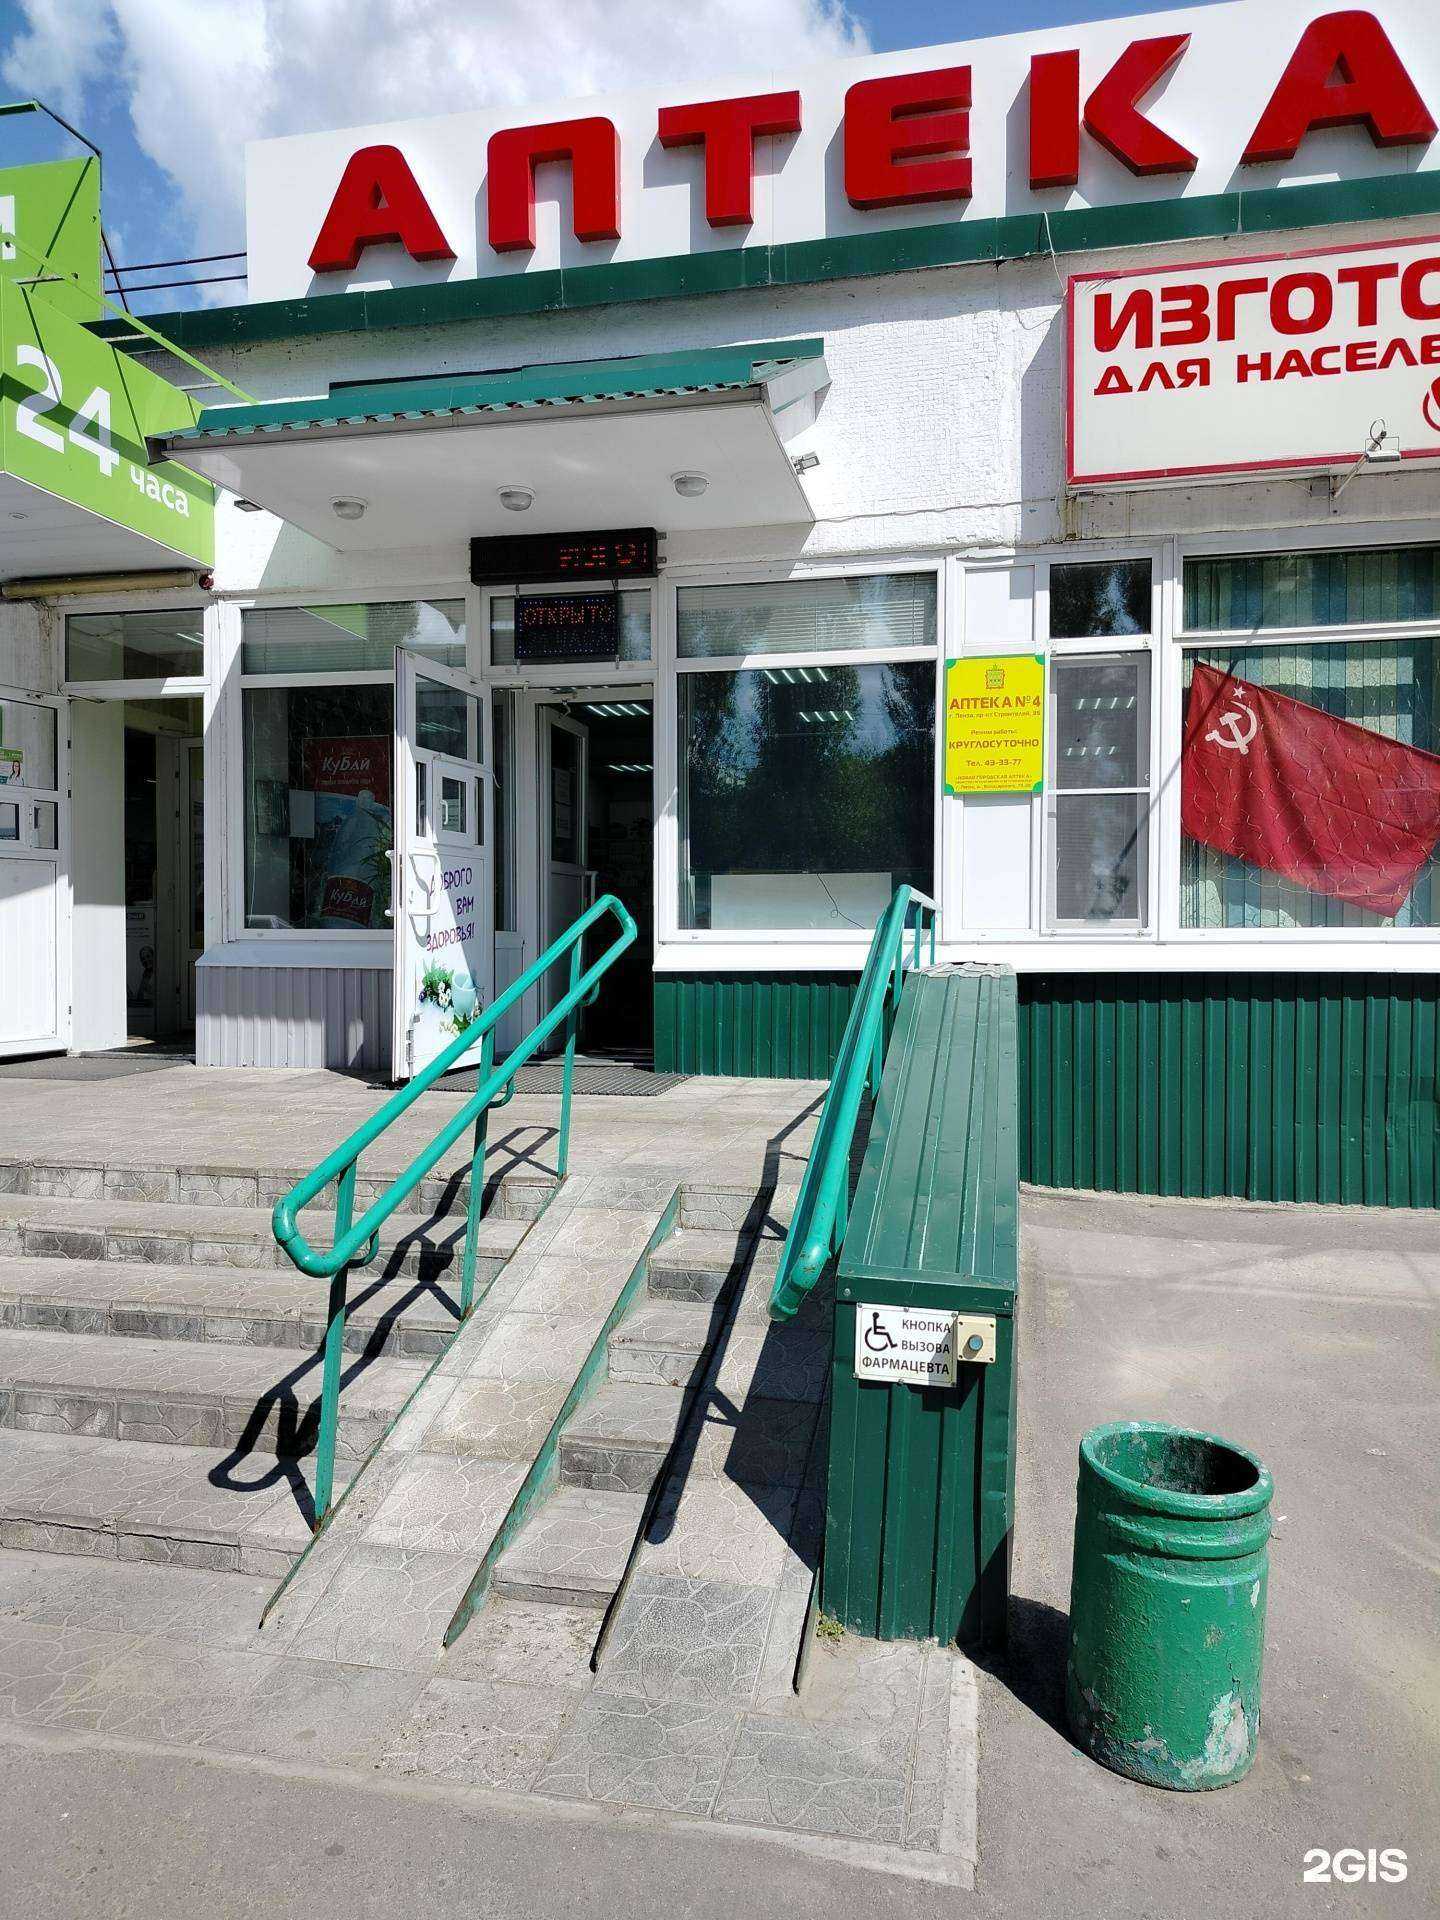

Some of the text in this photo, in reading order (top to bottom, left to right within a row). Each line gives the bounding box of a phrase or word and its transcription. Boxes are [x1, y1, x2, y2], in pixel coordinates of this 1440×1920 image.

[308, 10, 1439, 274] АПТЕКА
[1094, 256, 1440, 353] ИЗГОТО
[1094, 358, 1211, 396] ДЛЯ
[16, 344, 190, 518] 24 часа
[949, 696, 1012, 710] АПТЕКА
[949, 738, 1039, 749] КРУГЛОСУТОЧНО
[984, 758, 1022, 766] 43-33-77
[456, 896, 474, 915] ВАМ
[426, 922, 475, 953] ЗДОРОВЬЯ!
[902, 1319, 950, 1333] КНОПКА
[901, 1340, 950, 1354] ВЫЗОВА
[862, 1356, 950, 1375] ФАРМАЦЕВТА
